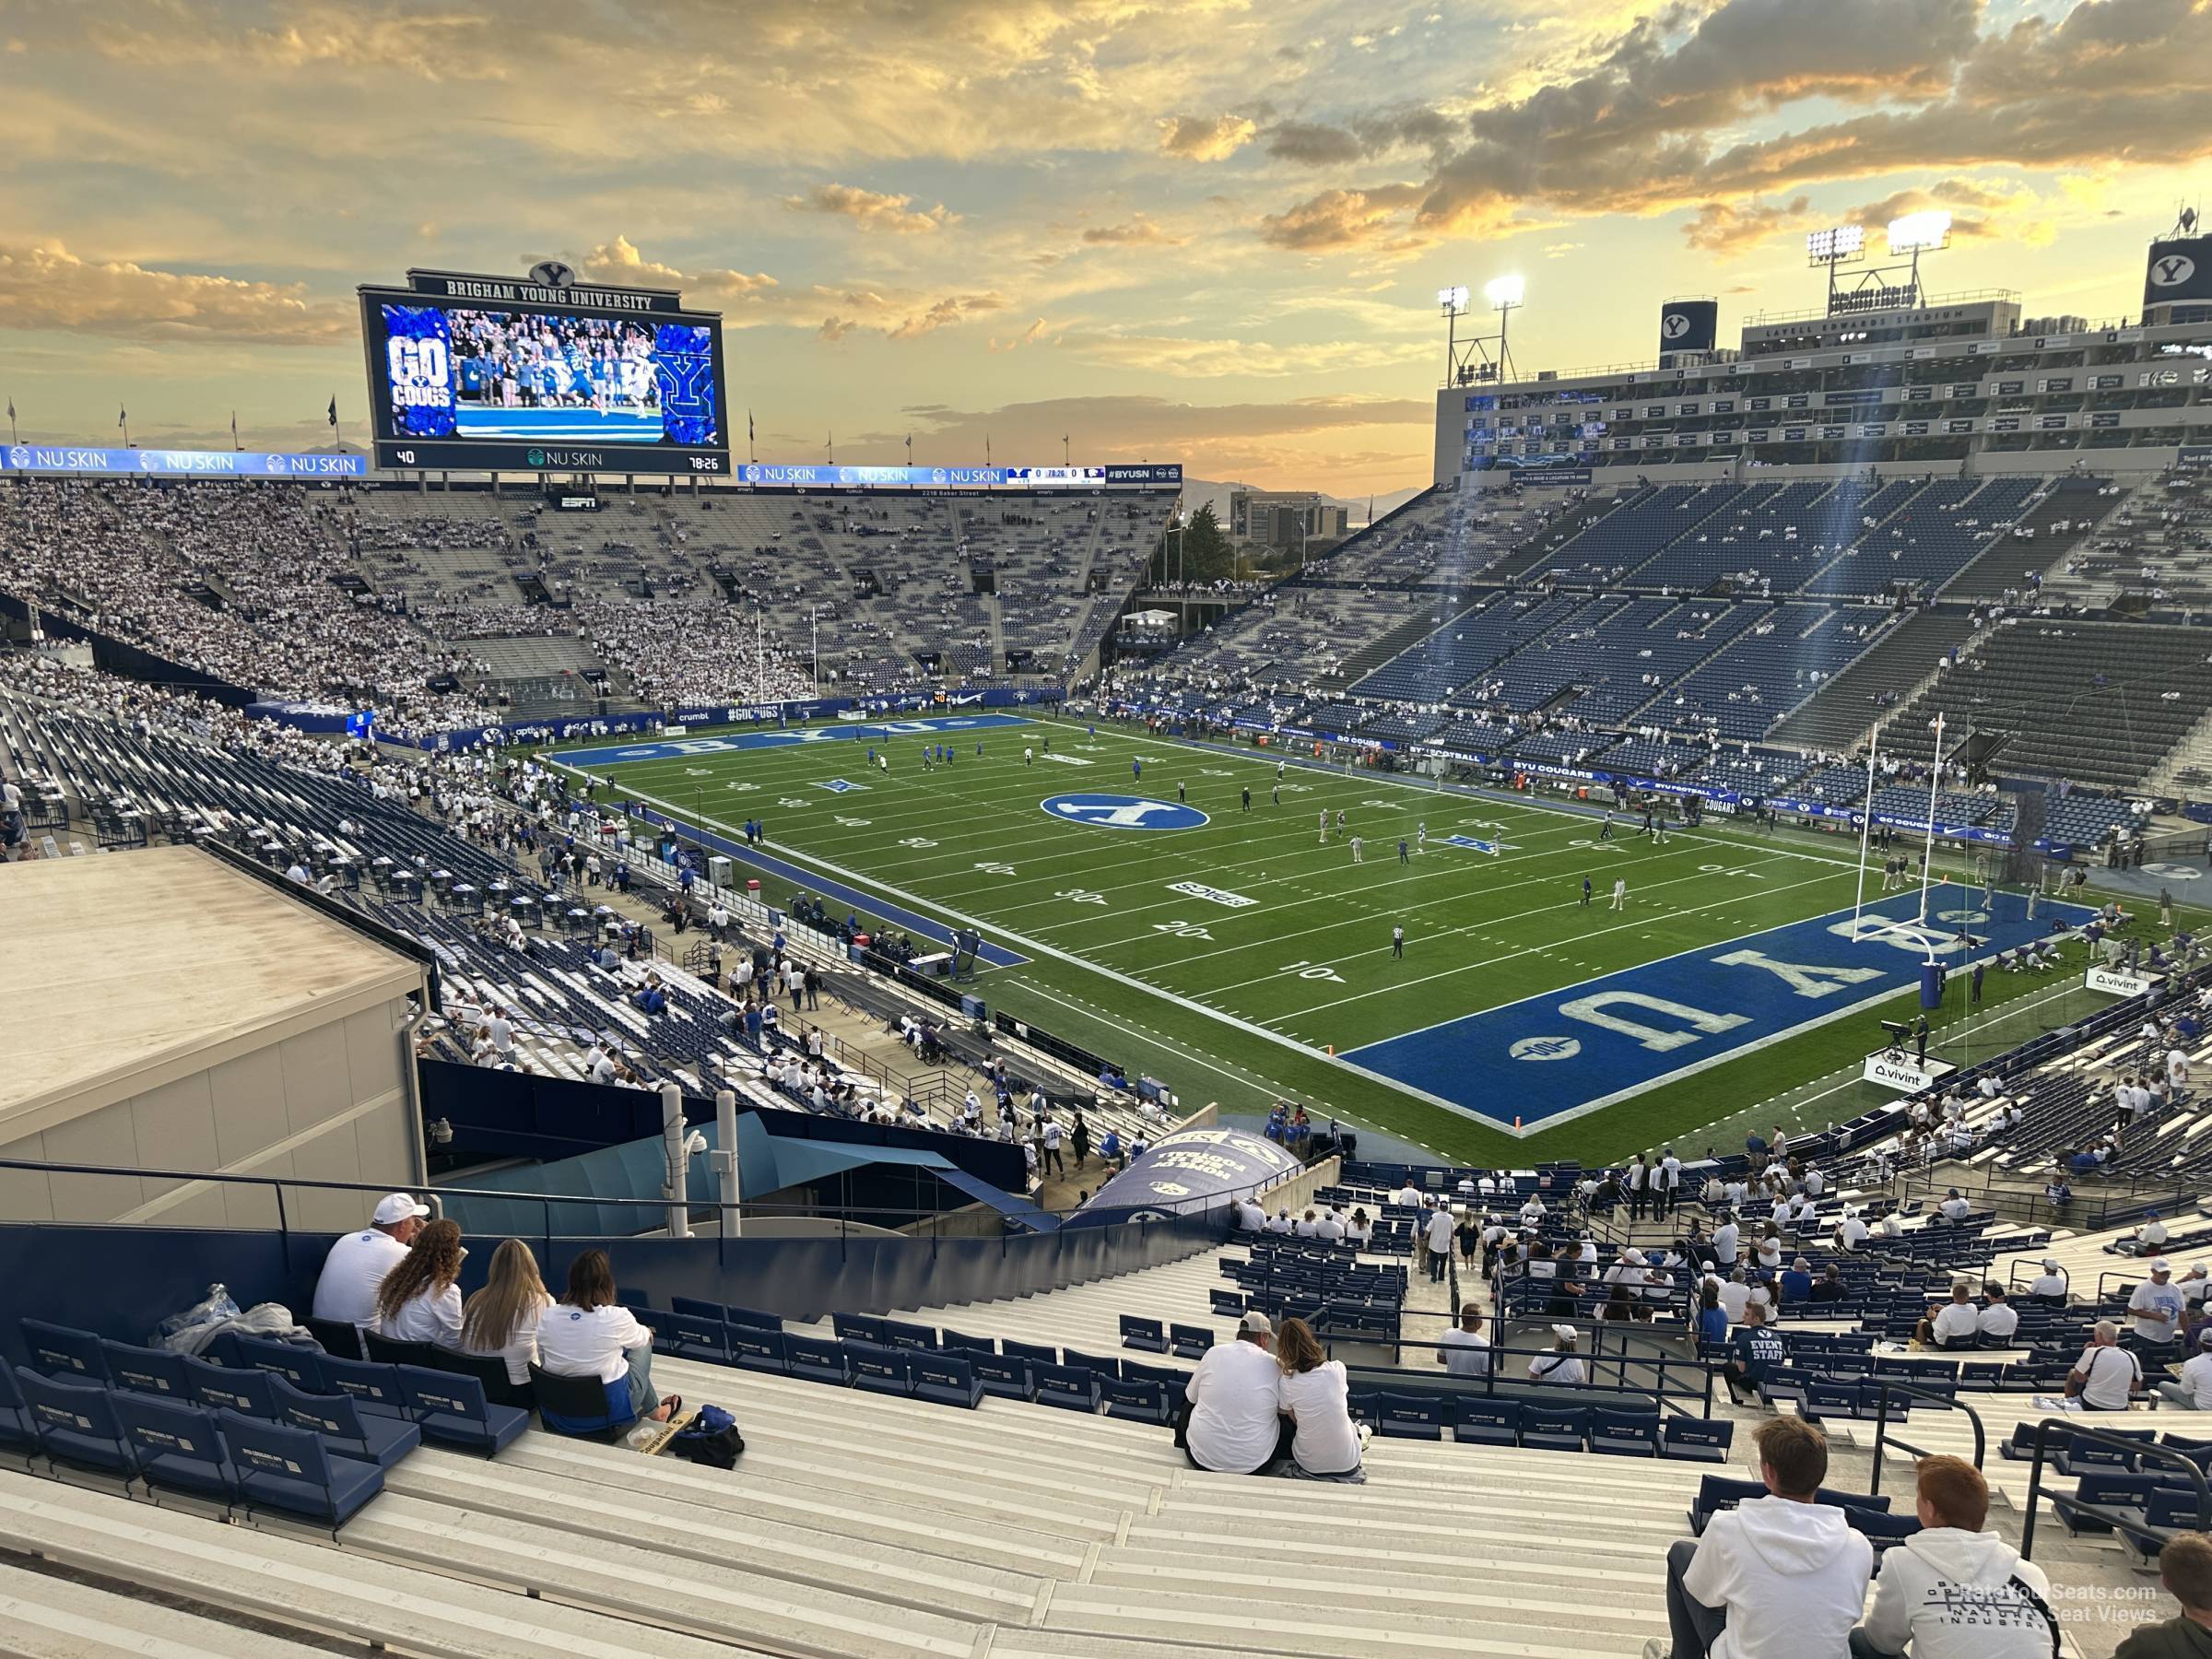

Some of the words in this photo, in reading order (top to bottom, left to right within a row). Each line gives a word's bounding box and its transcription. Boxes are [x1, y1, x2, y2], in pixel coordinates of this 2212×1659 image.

[542, 265, 570, 288] Y
[447, 281, 515, 300] BRIGHAM
[520, 287, 566, 304] YOUNG
[571, 291, 653, 310] UNIVERSITY
[1767, 325, 1812, 336] LAVELL
[1822, 318, 1886, 331] EDWARDS
[1897, 310, 1963, 324] STADIUM
[388, 335, 449, 386] GO
[658, 354, 712, 418] Y
[37, 452, 64, 466] NU
[68, 452, 107, 467] SKIN
[167, 454, 192, 469] NU
[194, 455, 233, 470] SKIN
[397, 451, 415, 464] 40
[547, 452, 568, 465] NU
[571, 453, 602, 465] SKIN
[689, 456, 719, 469] 78:26
[291, 457, 316, 472] NU
[320, 458, 356, 472] SKIN
[765, 468, 783, 481] NU
[787, 468, 816, 481] SKIN
[858, 469, 877, 481] NU
[879, 469, 908, 481] SKIN
[951, 471, 969, 482] NU
[971, 471, 1000, 482] SKIN
[1109, 470, 1150, 478] #BYUSN
[562, 498, 595, 508] ESPN
[935, 695, 946, 703] 40
[679, 712, 709, 721] crumbl
[1513, 761, 1536, 771] BYU
[1537, 765, 1594, 779] COUGARS
[1671, 785, 1711, 796] FOOTBALL
[1705, 798, 1735, 814] COUGARS
[1054, 800, 1183, 827] Y
[1878, 816, 1894, 824] GO
[898, 837, 938, 849] 50
[973, 861, 1006, 874] 40
[1054, 888, 1102, 903] 30
[1152, 921, 1203, 937] 20
[1279, 960, 1335, 979] 10
[1157, 1151, 1246, 1172] FOOTBALL
[1178, 1161, 1232, 1180] HOME
[1750, 1340, 1783, 1350] EVENT
[1753, 1349, 1783, 1360] STAFF
[1954, 1609, 2034, 1620] NATURE
[1940, 1617, 2044, 1630] INDUSTRY
